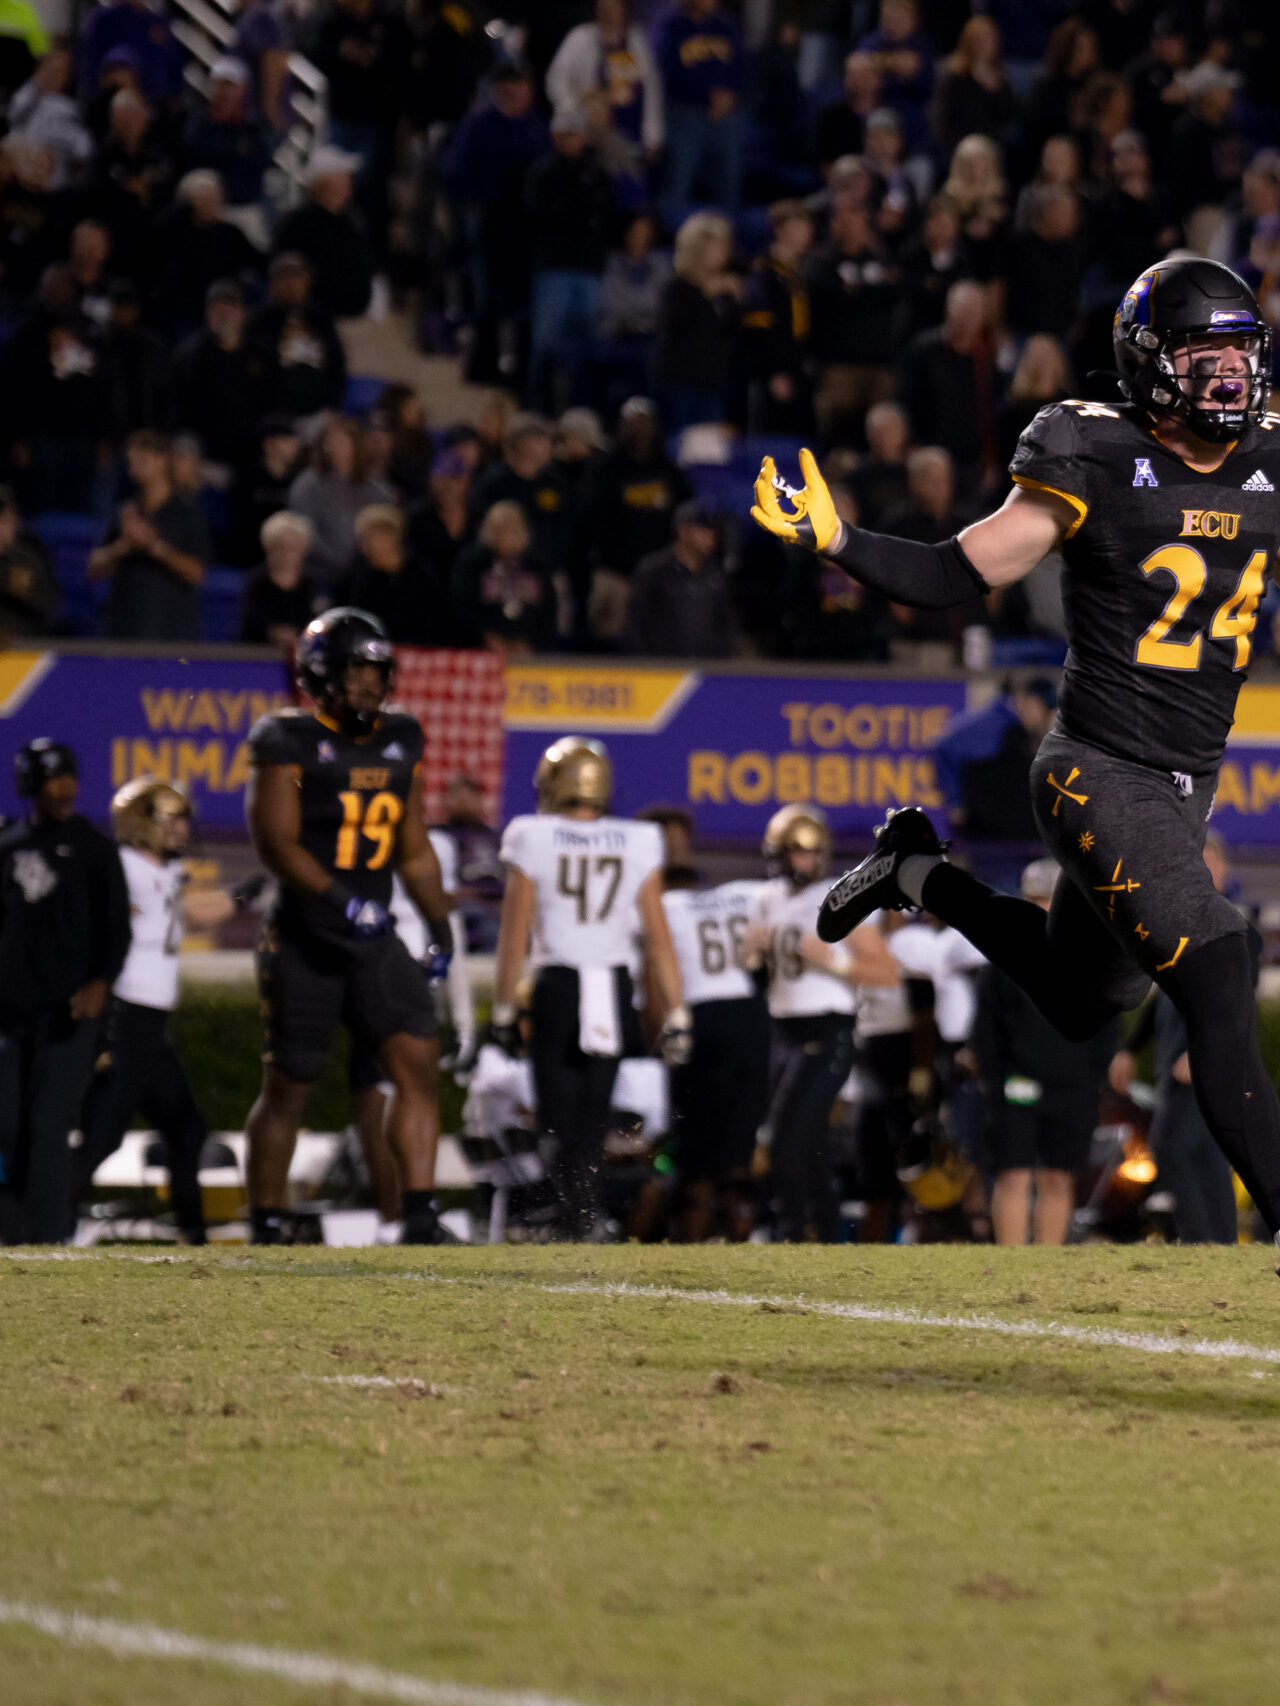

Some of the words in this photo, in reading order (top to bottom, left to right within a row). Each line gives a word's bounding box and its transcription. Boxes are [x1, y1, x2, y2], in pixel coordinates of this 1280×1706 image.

[1241, 481, 1276, 492] adidas
[1178, 509, 1241, 540] ECU
[1133, 542, 1268, 673] 24
[688, 751, 942, 807] ROBBINS
[334, 790, 402, 871] 19
[557, 853, 623, 925] 47
